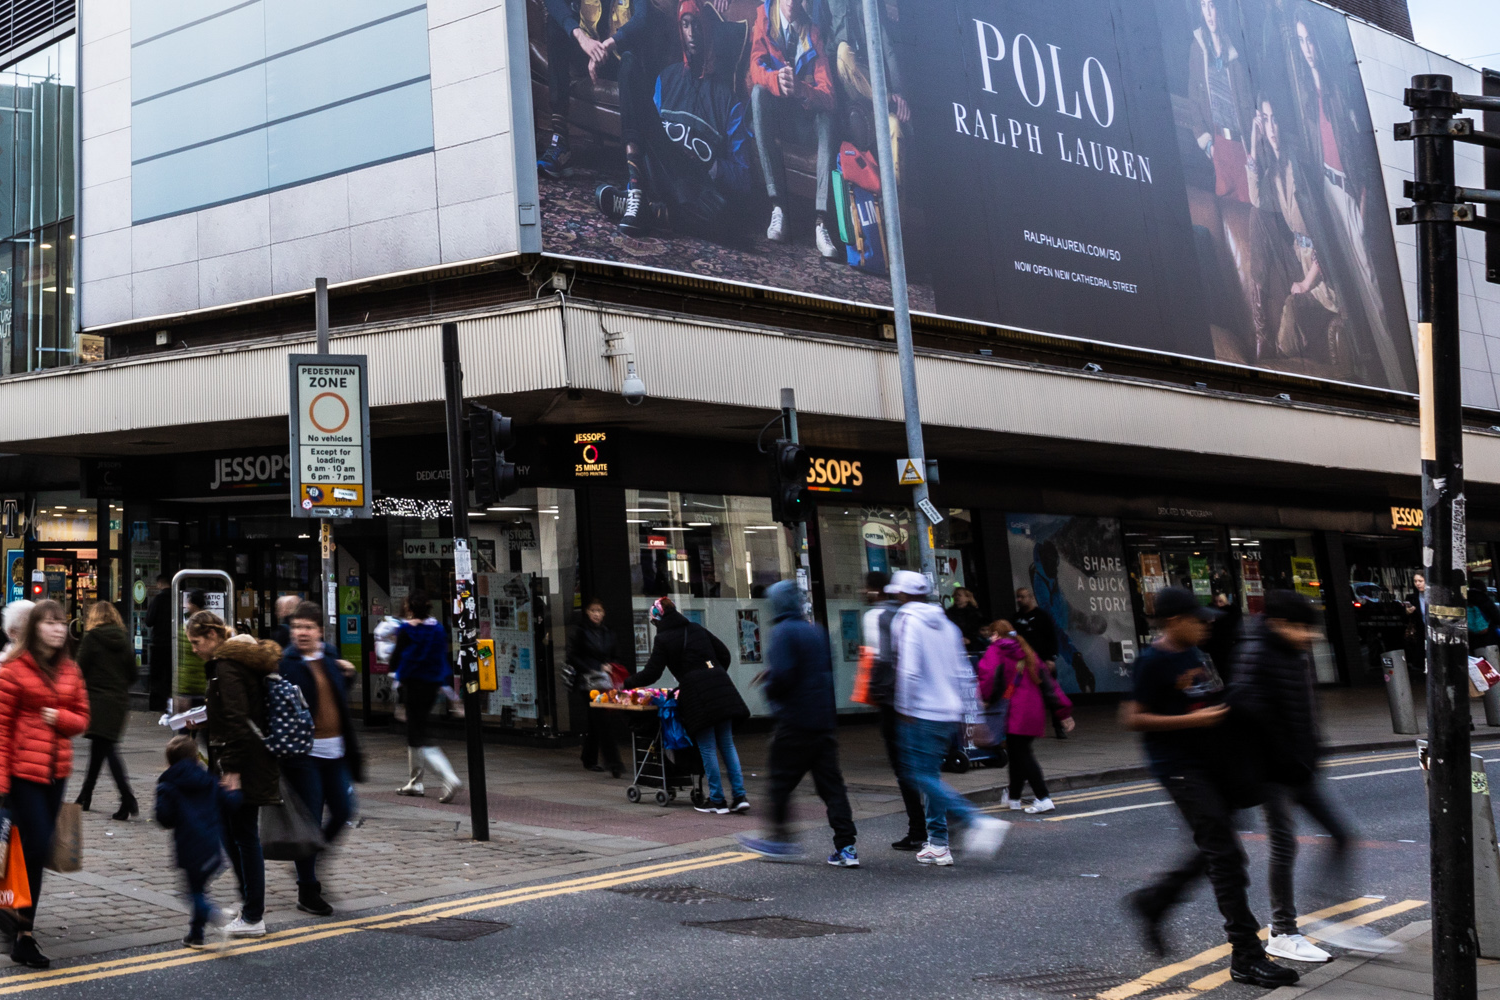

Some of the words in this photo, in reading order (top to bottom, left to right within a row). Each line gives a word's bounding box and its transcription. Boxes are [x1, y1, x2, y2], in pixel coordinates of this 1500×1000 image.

[972, 18, 1114, 128] POLO
[952, 102, 1043, 155] RALPH
[1057, 132, 1152, 184] LAUREN
[1024, 230, 1121, 262] RALPHLAUREN.COM/50
[1014, 260, 1032, 273] NOW
[1033, 265, 1053, 277] OPEN
[1054, 269, 1070, 280] NEW
[1071, 272, 1112, 289] CATHEDRAL
[1112, 281, 1138, 294] STREET
[309, 377, 347, 388] ZONE
[574, 432, 606, 444] JESSOPS
[311, 448, 338, 456] Except
[210, 455, 290, 490] JESSOPS
[416, 470, 451, 481] DEDICATE
[806, 457, 863, 486] SSOPS
[1390, 507, 1424, 530] JESSOP
[405, 542, 426, 554] love
[429, 542, 438, 554] it.
[1084, 556, 1121, 571] SHARE
[1077, 578, 1085, 591] A
[1088, 578, 1125, 592] QUICK
[1090, 597, 1127, 612] STORY
[1121, 640, 1136, 664] 6
